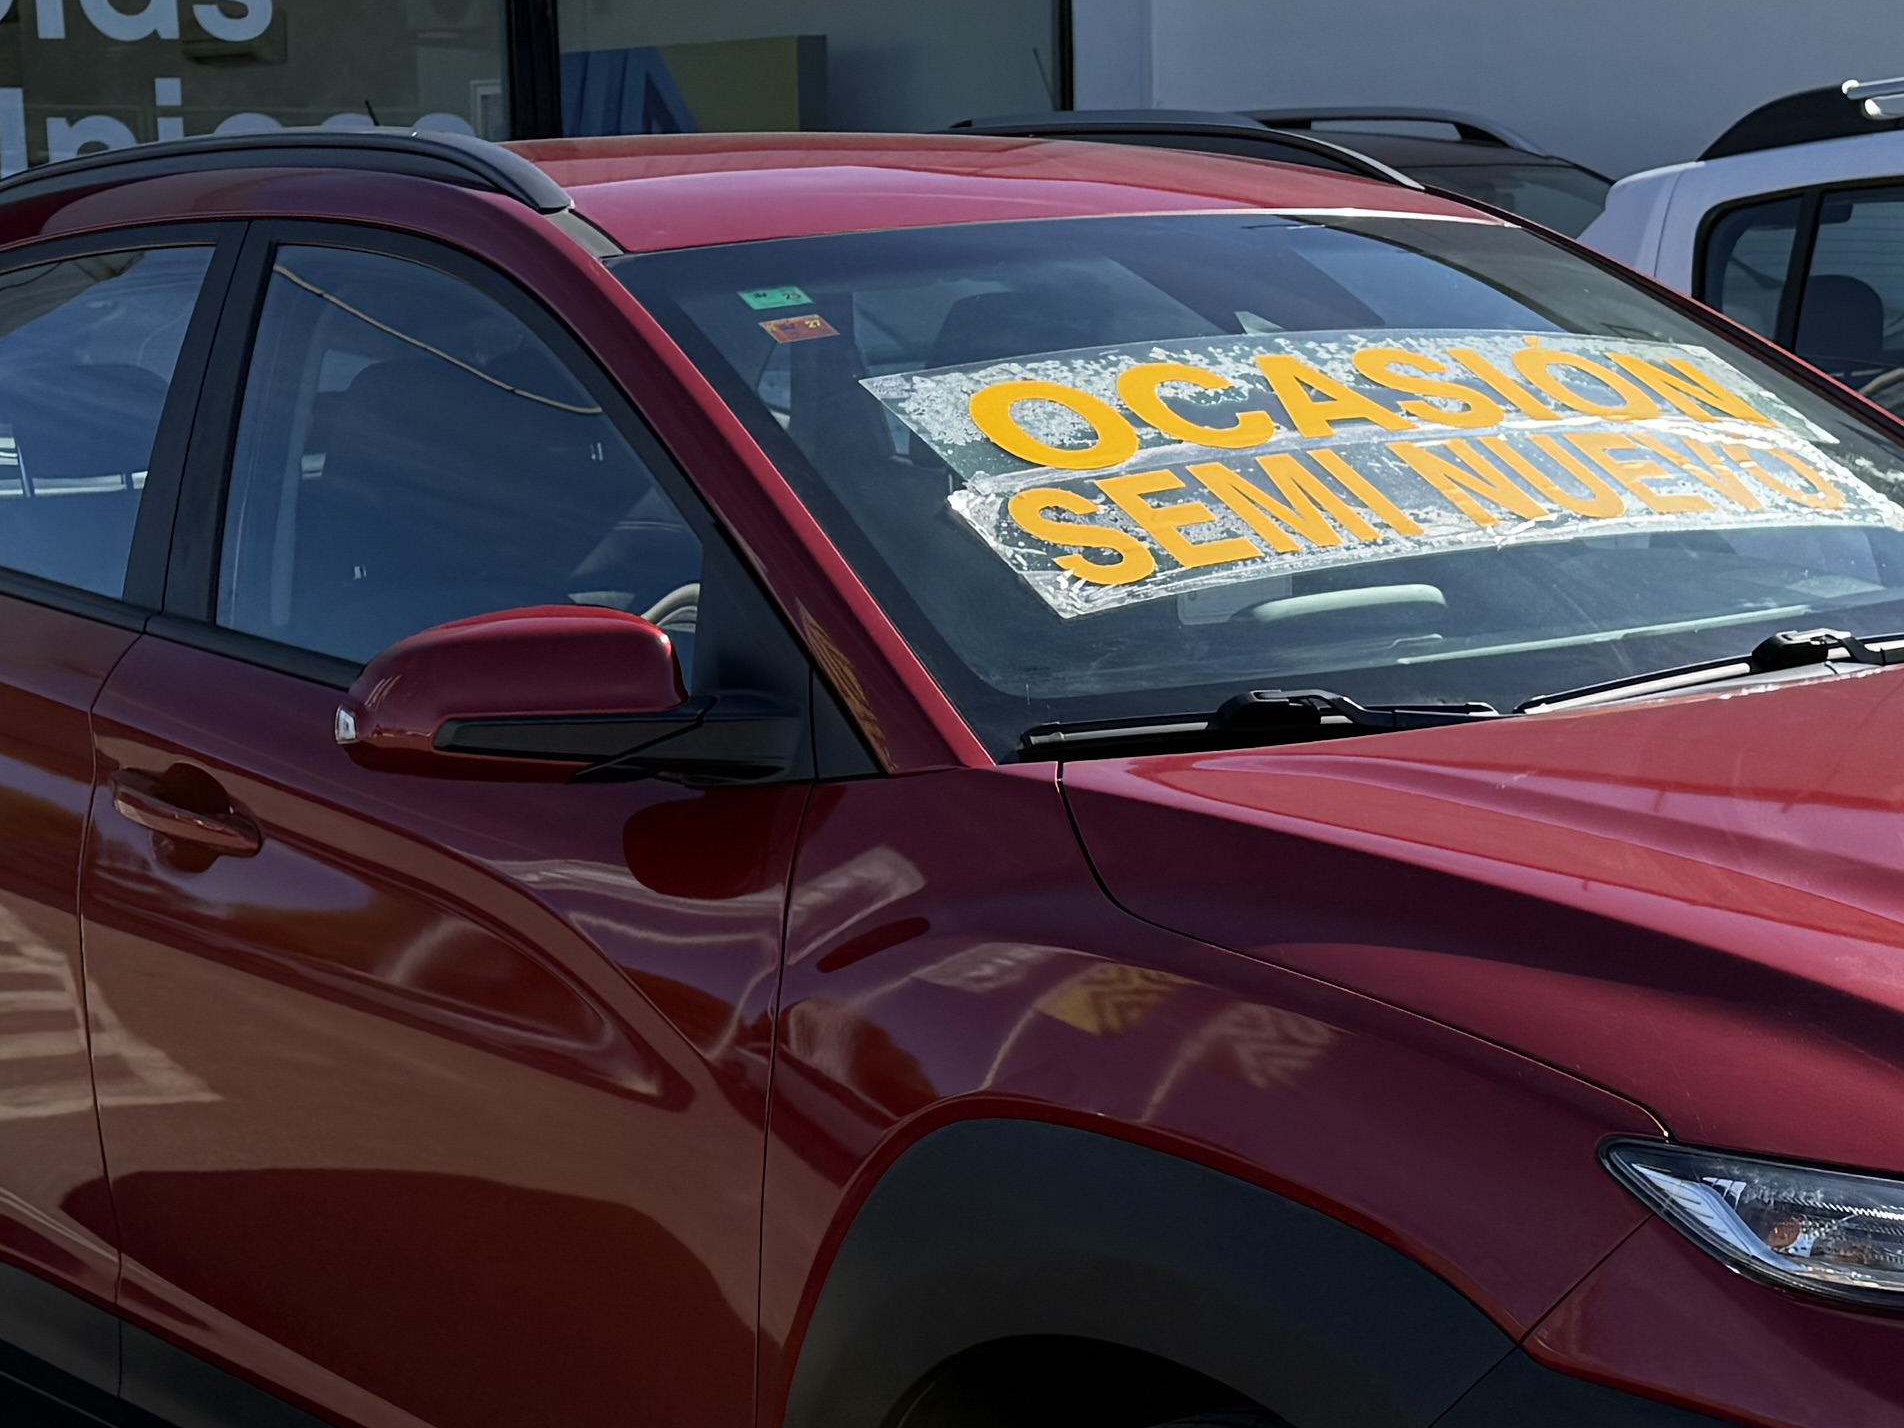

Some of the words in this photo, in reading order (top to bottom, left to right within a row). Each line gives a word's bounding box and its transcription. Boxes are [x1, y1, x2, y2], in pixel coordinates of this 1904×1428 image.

[804, 319, 821, 328] 27
[969, 335, 1785, 470] OCASIÓN
[1007, 446, 1423, 586] SEMI
[1387, 429, 1847, 529] NUEVO
